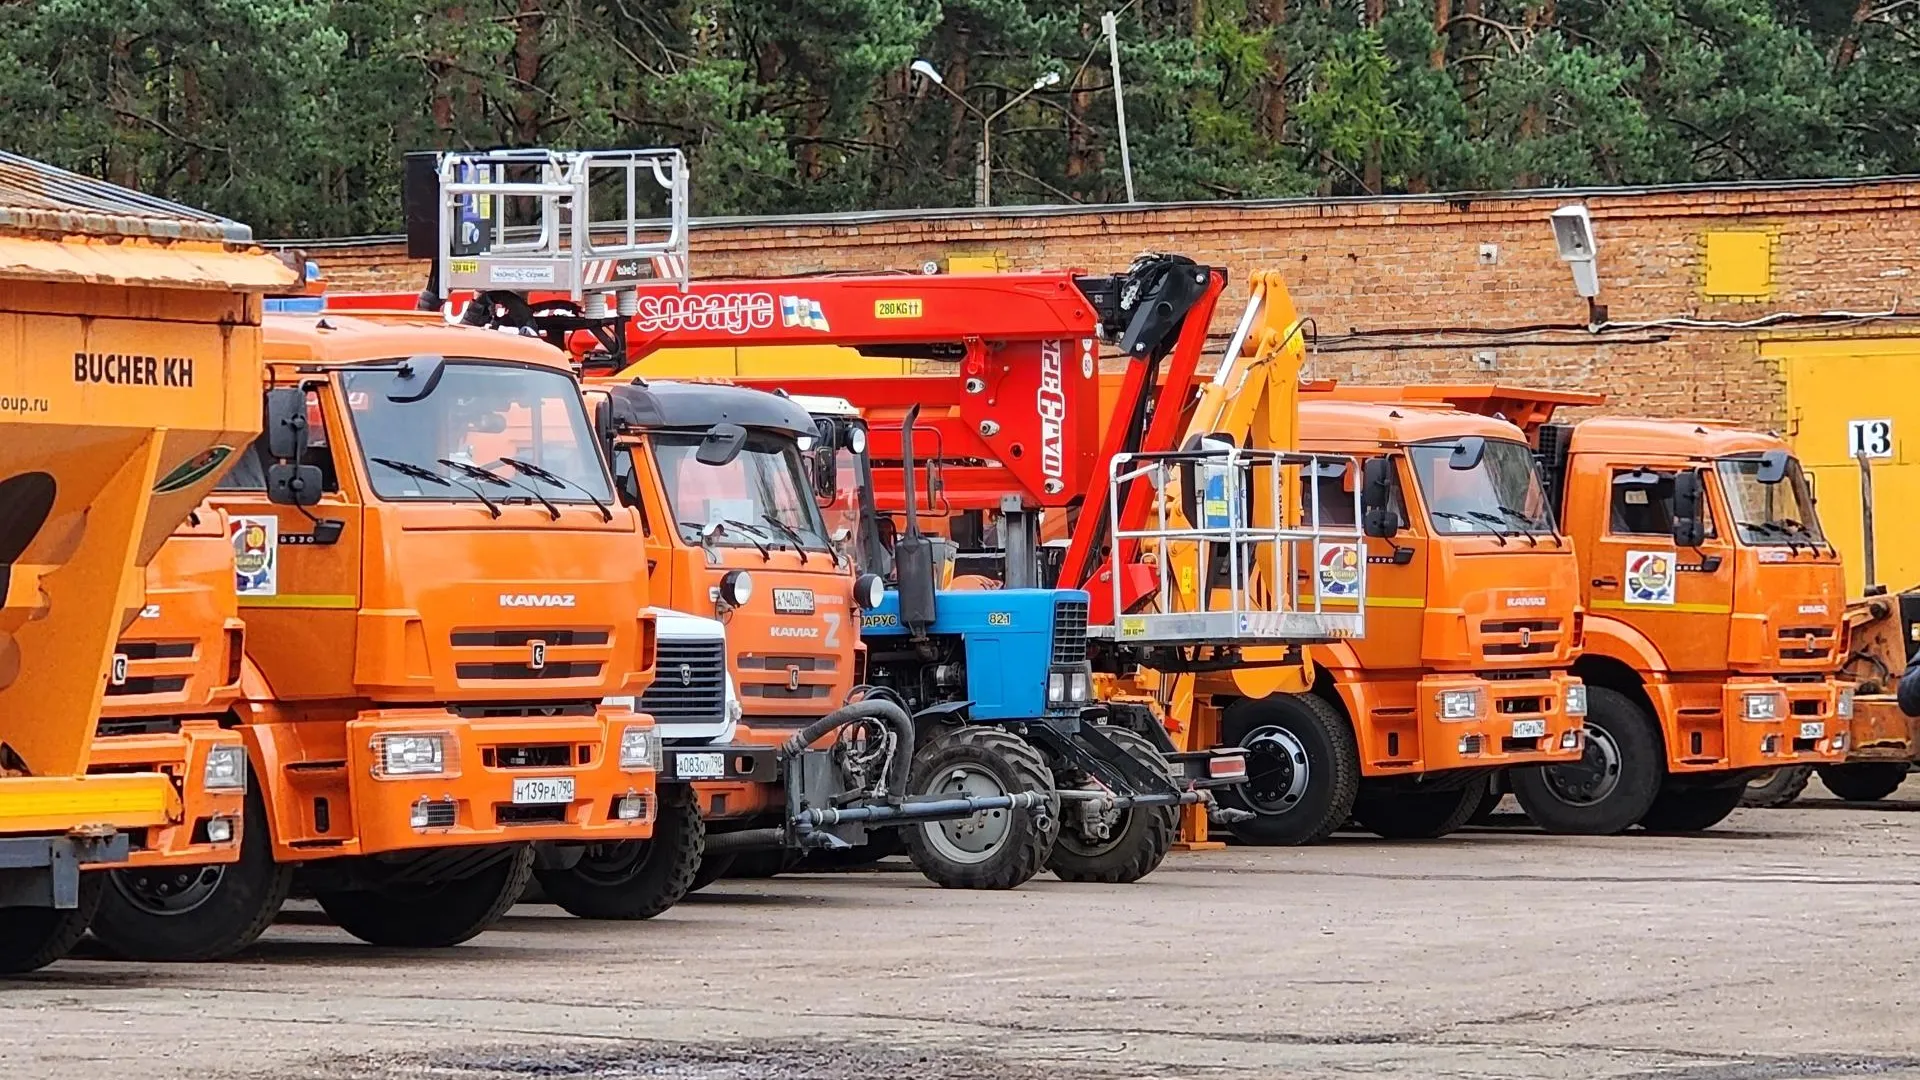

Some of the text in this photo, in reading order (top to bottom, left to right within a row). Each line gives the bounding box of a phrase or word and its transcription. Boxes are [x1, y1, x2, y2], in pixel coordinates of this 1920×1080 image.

[637, 293, 774, 335] socage
[879, 302, 908, 315] 280 KG
[74, 353, 193, 388] BUCHER KH
[0, 397, 49, 415] oup.ru
[1854, 421, 1891, 455] 13
[499, 594, 576, 607] KAMAZ
[770, 626, 819, 638] KAMAZ
[516, 780, 572, 800] Н139РА 790
